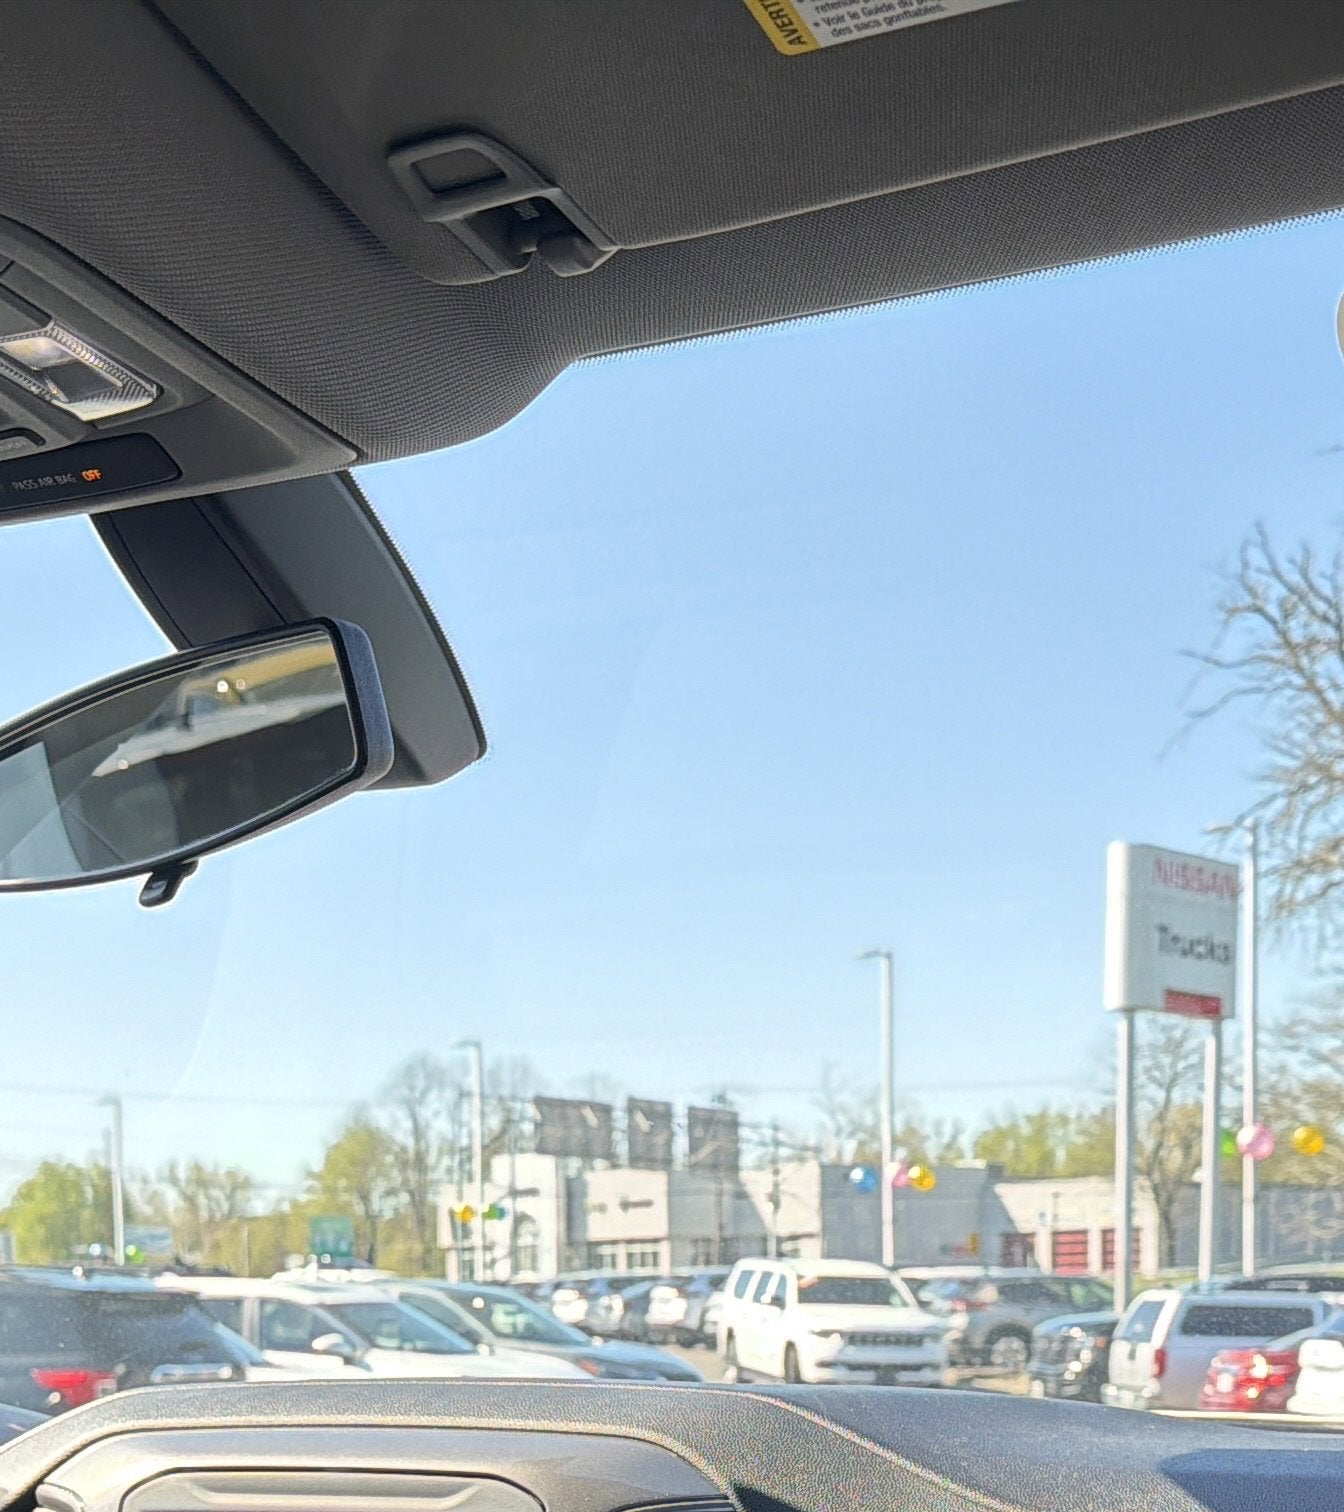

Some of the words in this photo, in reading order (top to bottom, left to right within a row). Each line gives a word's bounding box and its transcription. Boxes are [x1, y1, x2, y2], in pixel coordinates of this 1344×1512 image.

[11, 479, 38, 491] PASS
[37, 476, 59, 488] AIR
[56, 473, 77, 485] BAG
[82, 469, 103, 481] OFF
[1153, 857, 1242, 898] NISSAN
